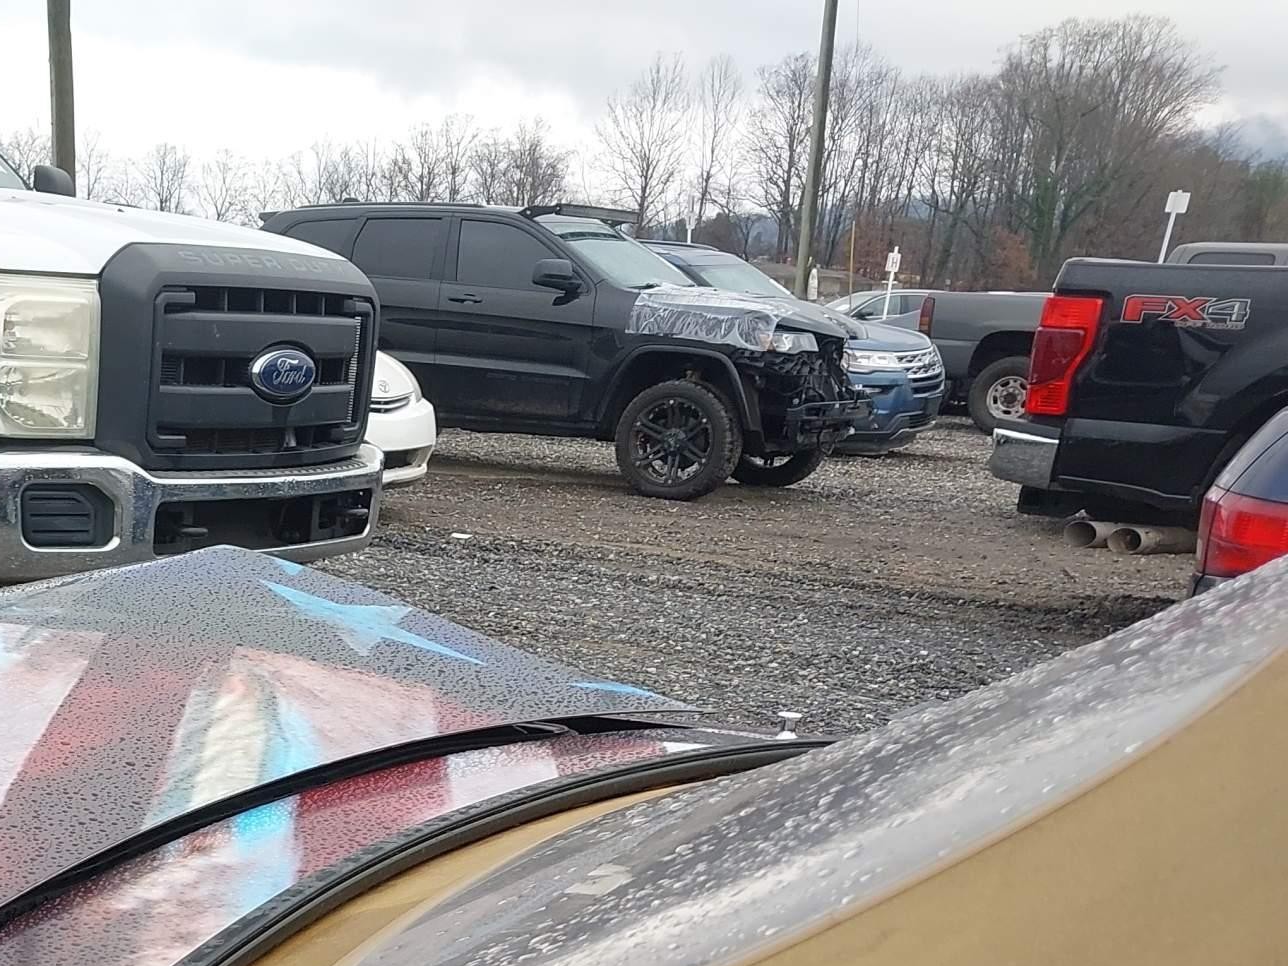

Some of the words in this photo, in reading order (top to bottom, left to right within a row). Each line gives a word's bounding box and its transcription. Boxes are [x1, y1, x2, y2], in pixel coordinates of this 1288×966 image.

[178, 250, 281, 270] SUPER
[1120, 293, 1251, 324] FX4
[272, 357, 307, 385] Ford
